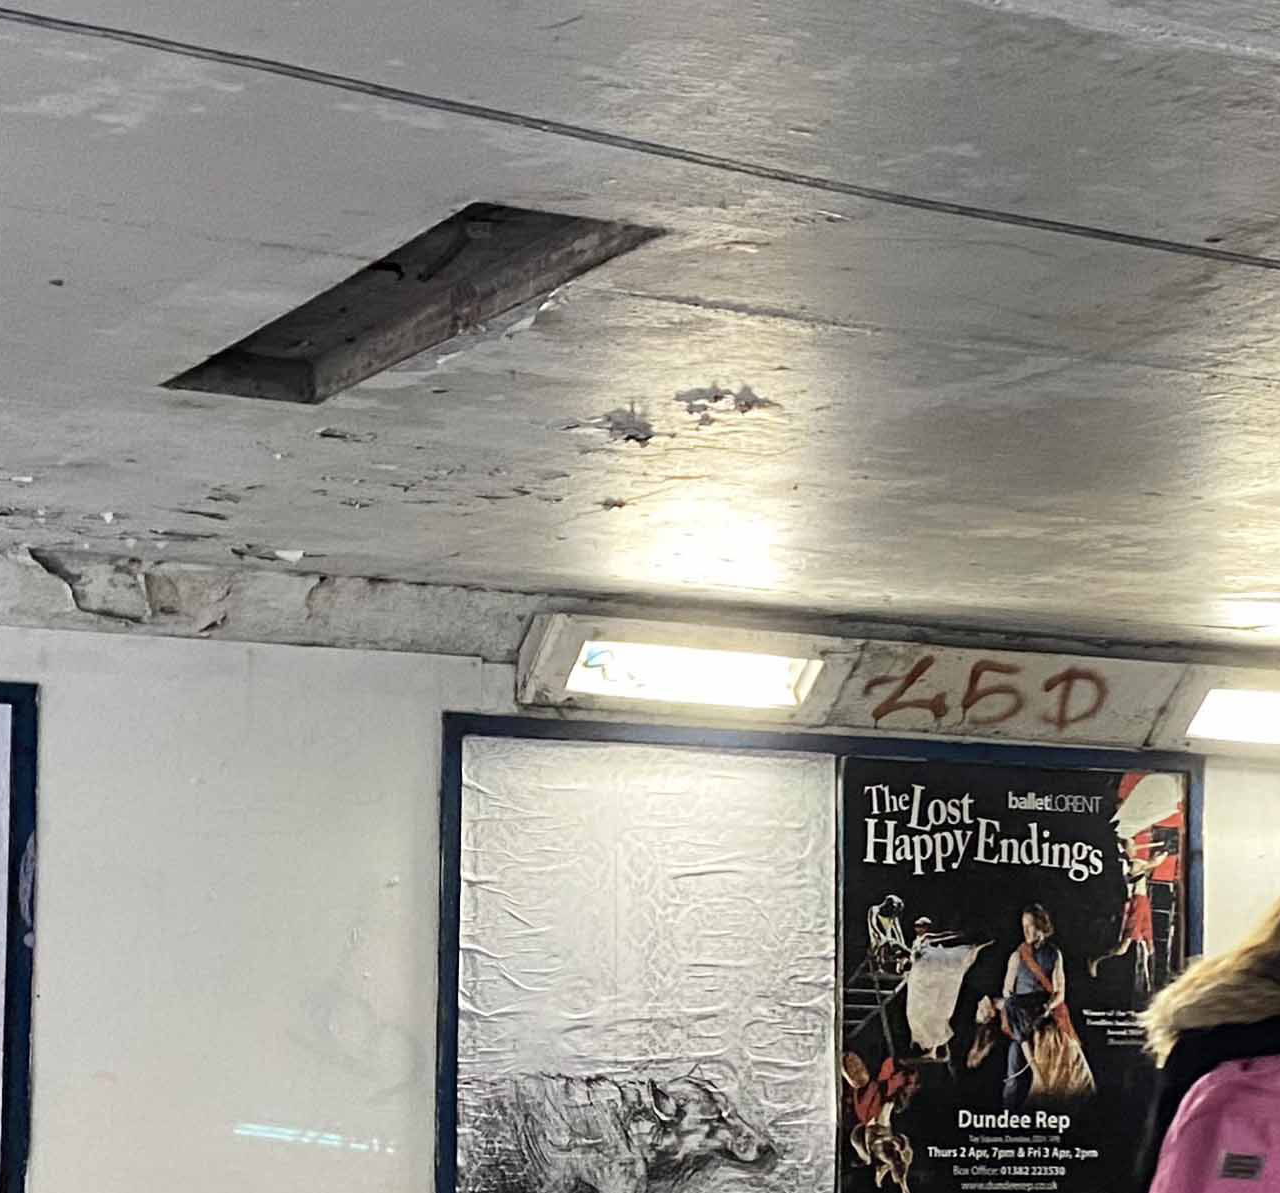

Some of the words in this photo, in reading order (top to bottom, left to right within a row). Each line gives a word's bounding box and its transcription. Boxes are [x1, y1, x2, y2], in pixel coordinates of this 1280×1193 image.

[864, 784, 910, 815] The
[907, 784, 974, 831] Lost
[863, 818, 973, 875] Happy
[974, 817, 1104, 882] Endings
[958, 1109, 1031, 1129] Dundee
[1035, 1110, 1071, 1134] Rep
[927, 1146, 958, 1158] Thurs
[959, 1147, 967, 1158] 2
[1017, 1147, 1025, 1158] &
[1027, 1147, 1041, 1158] Fri
[1042, 1148, 1050, 1158] 3
